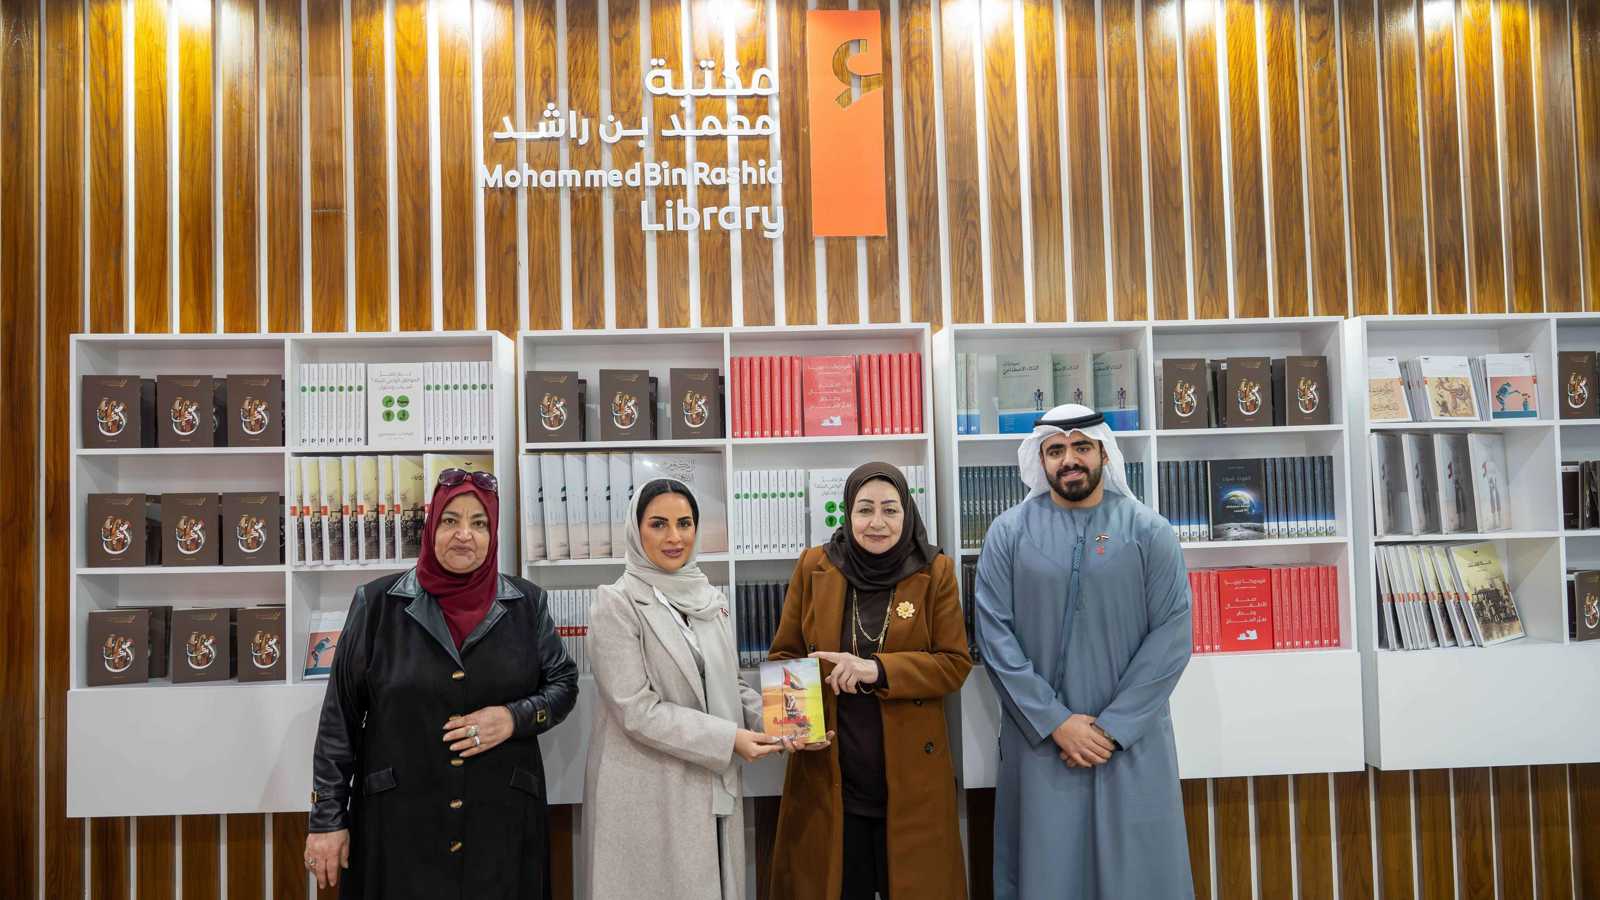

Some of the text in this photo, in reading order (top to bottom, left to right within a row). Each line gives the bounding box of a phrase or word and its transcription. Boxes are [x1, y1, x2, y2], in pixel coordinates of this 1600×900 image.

[645, 58, 780, 109] مكتبة
[493, 102, 778, 149] محمد بن راشد
[480, 159, 783, 189] Mohammed Bin Rashid
[641, 200, 785, 238] Library
